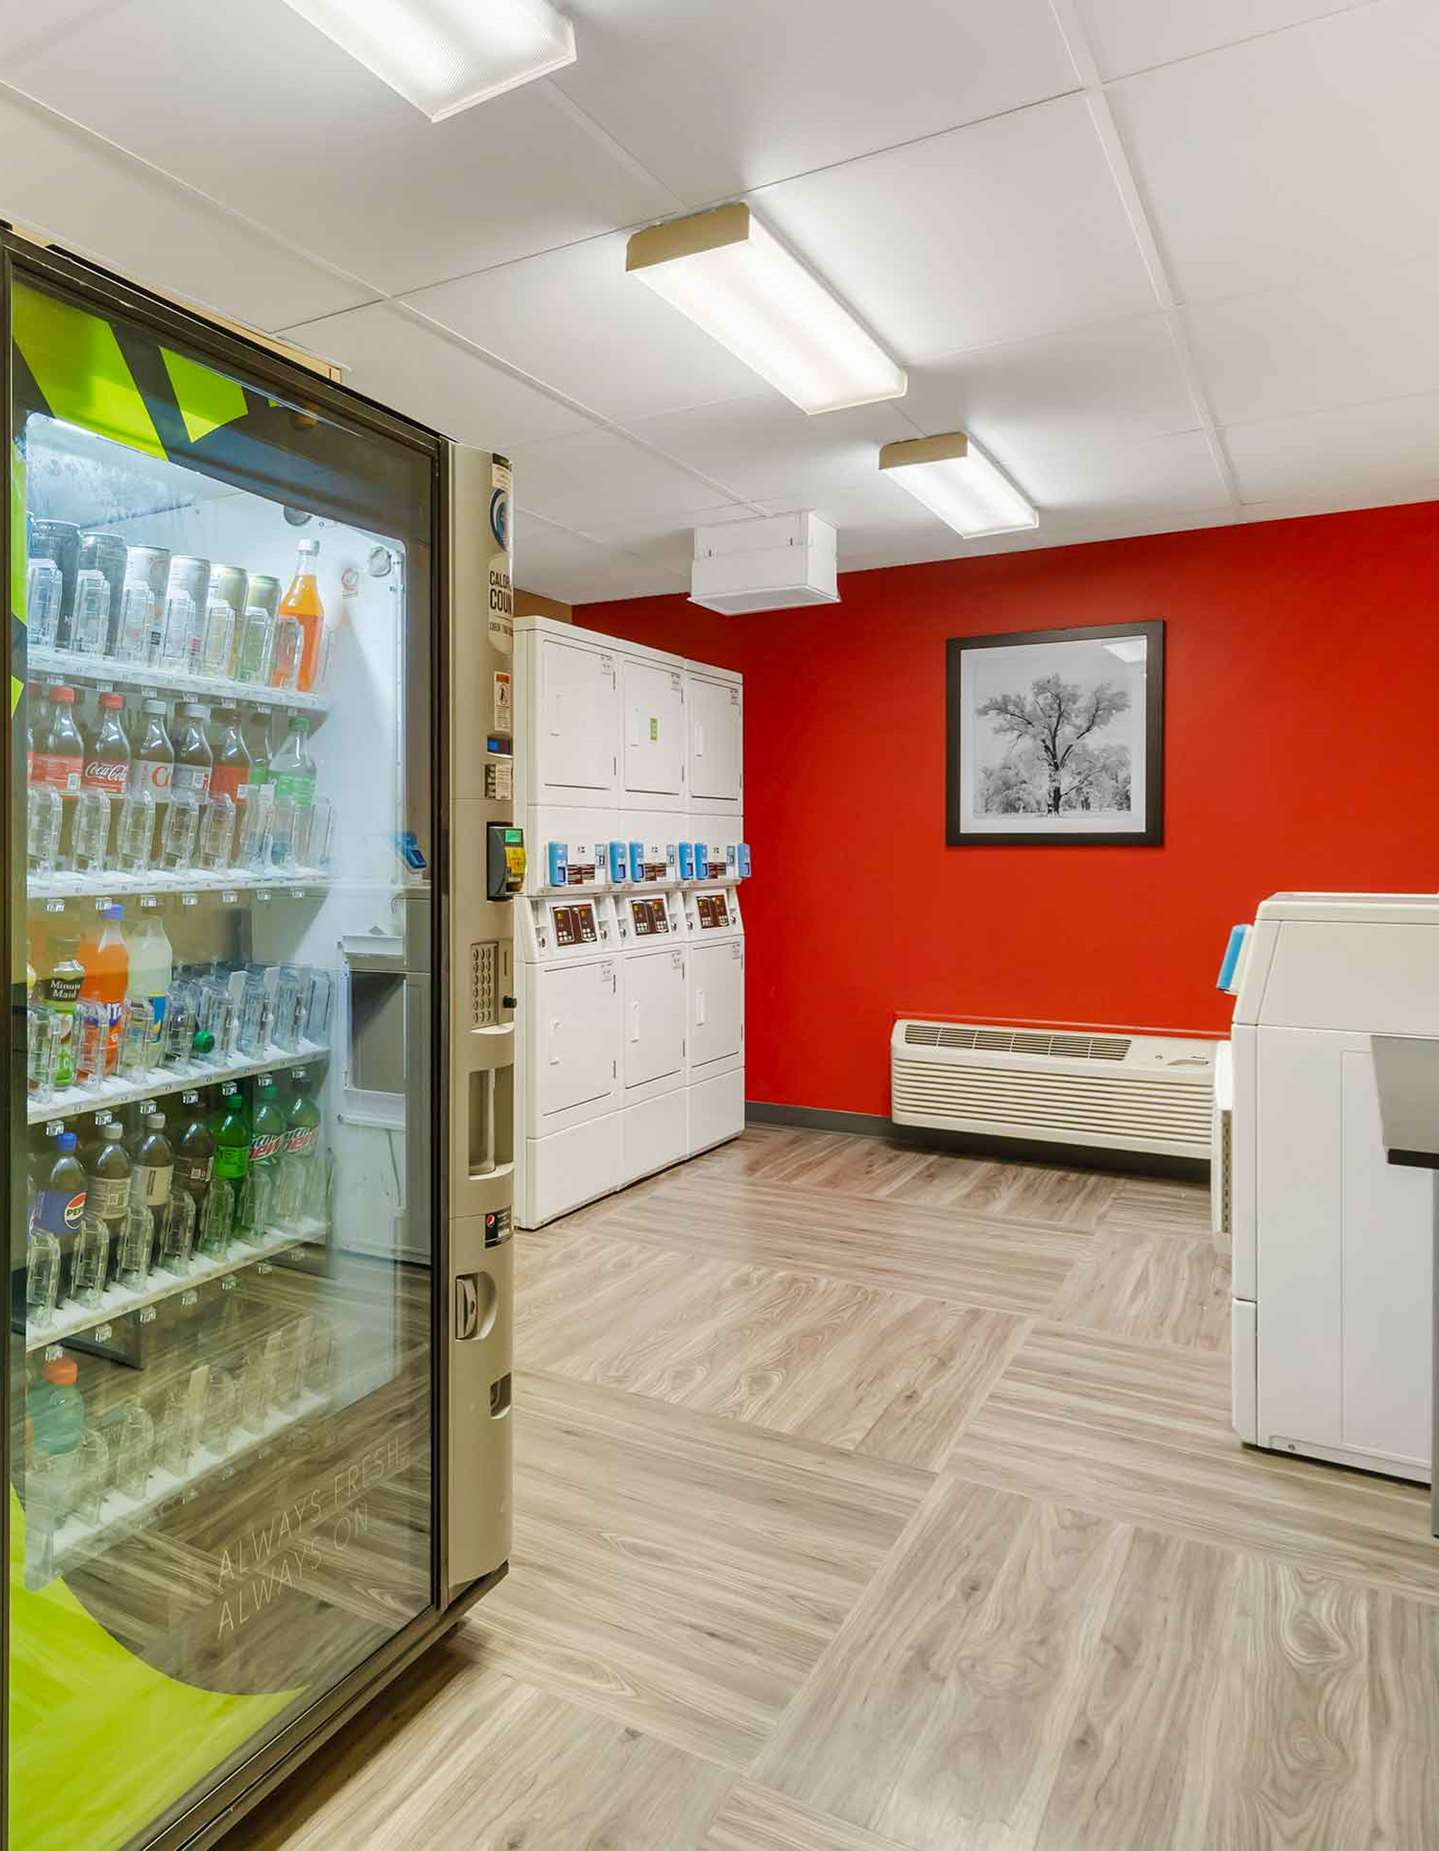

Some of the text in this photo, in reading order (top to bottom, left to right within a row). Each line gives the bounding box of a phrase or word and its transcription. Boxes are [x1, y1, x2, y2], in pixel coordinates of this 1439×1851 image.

[52, 990, 77, 999] Maid
[216, 1502, 369, 1640] ALWAYS ON
[217, 1488, 322, 1588] ALWAYS
